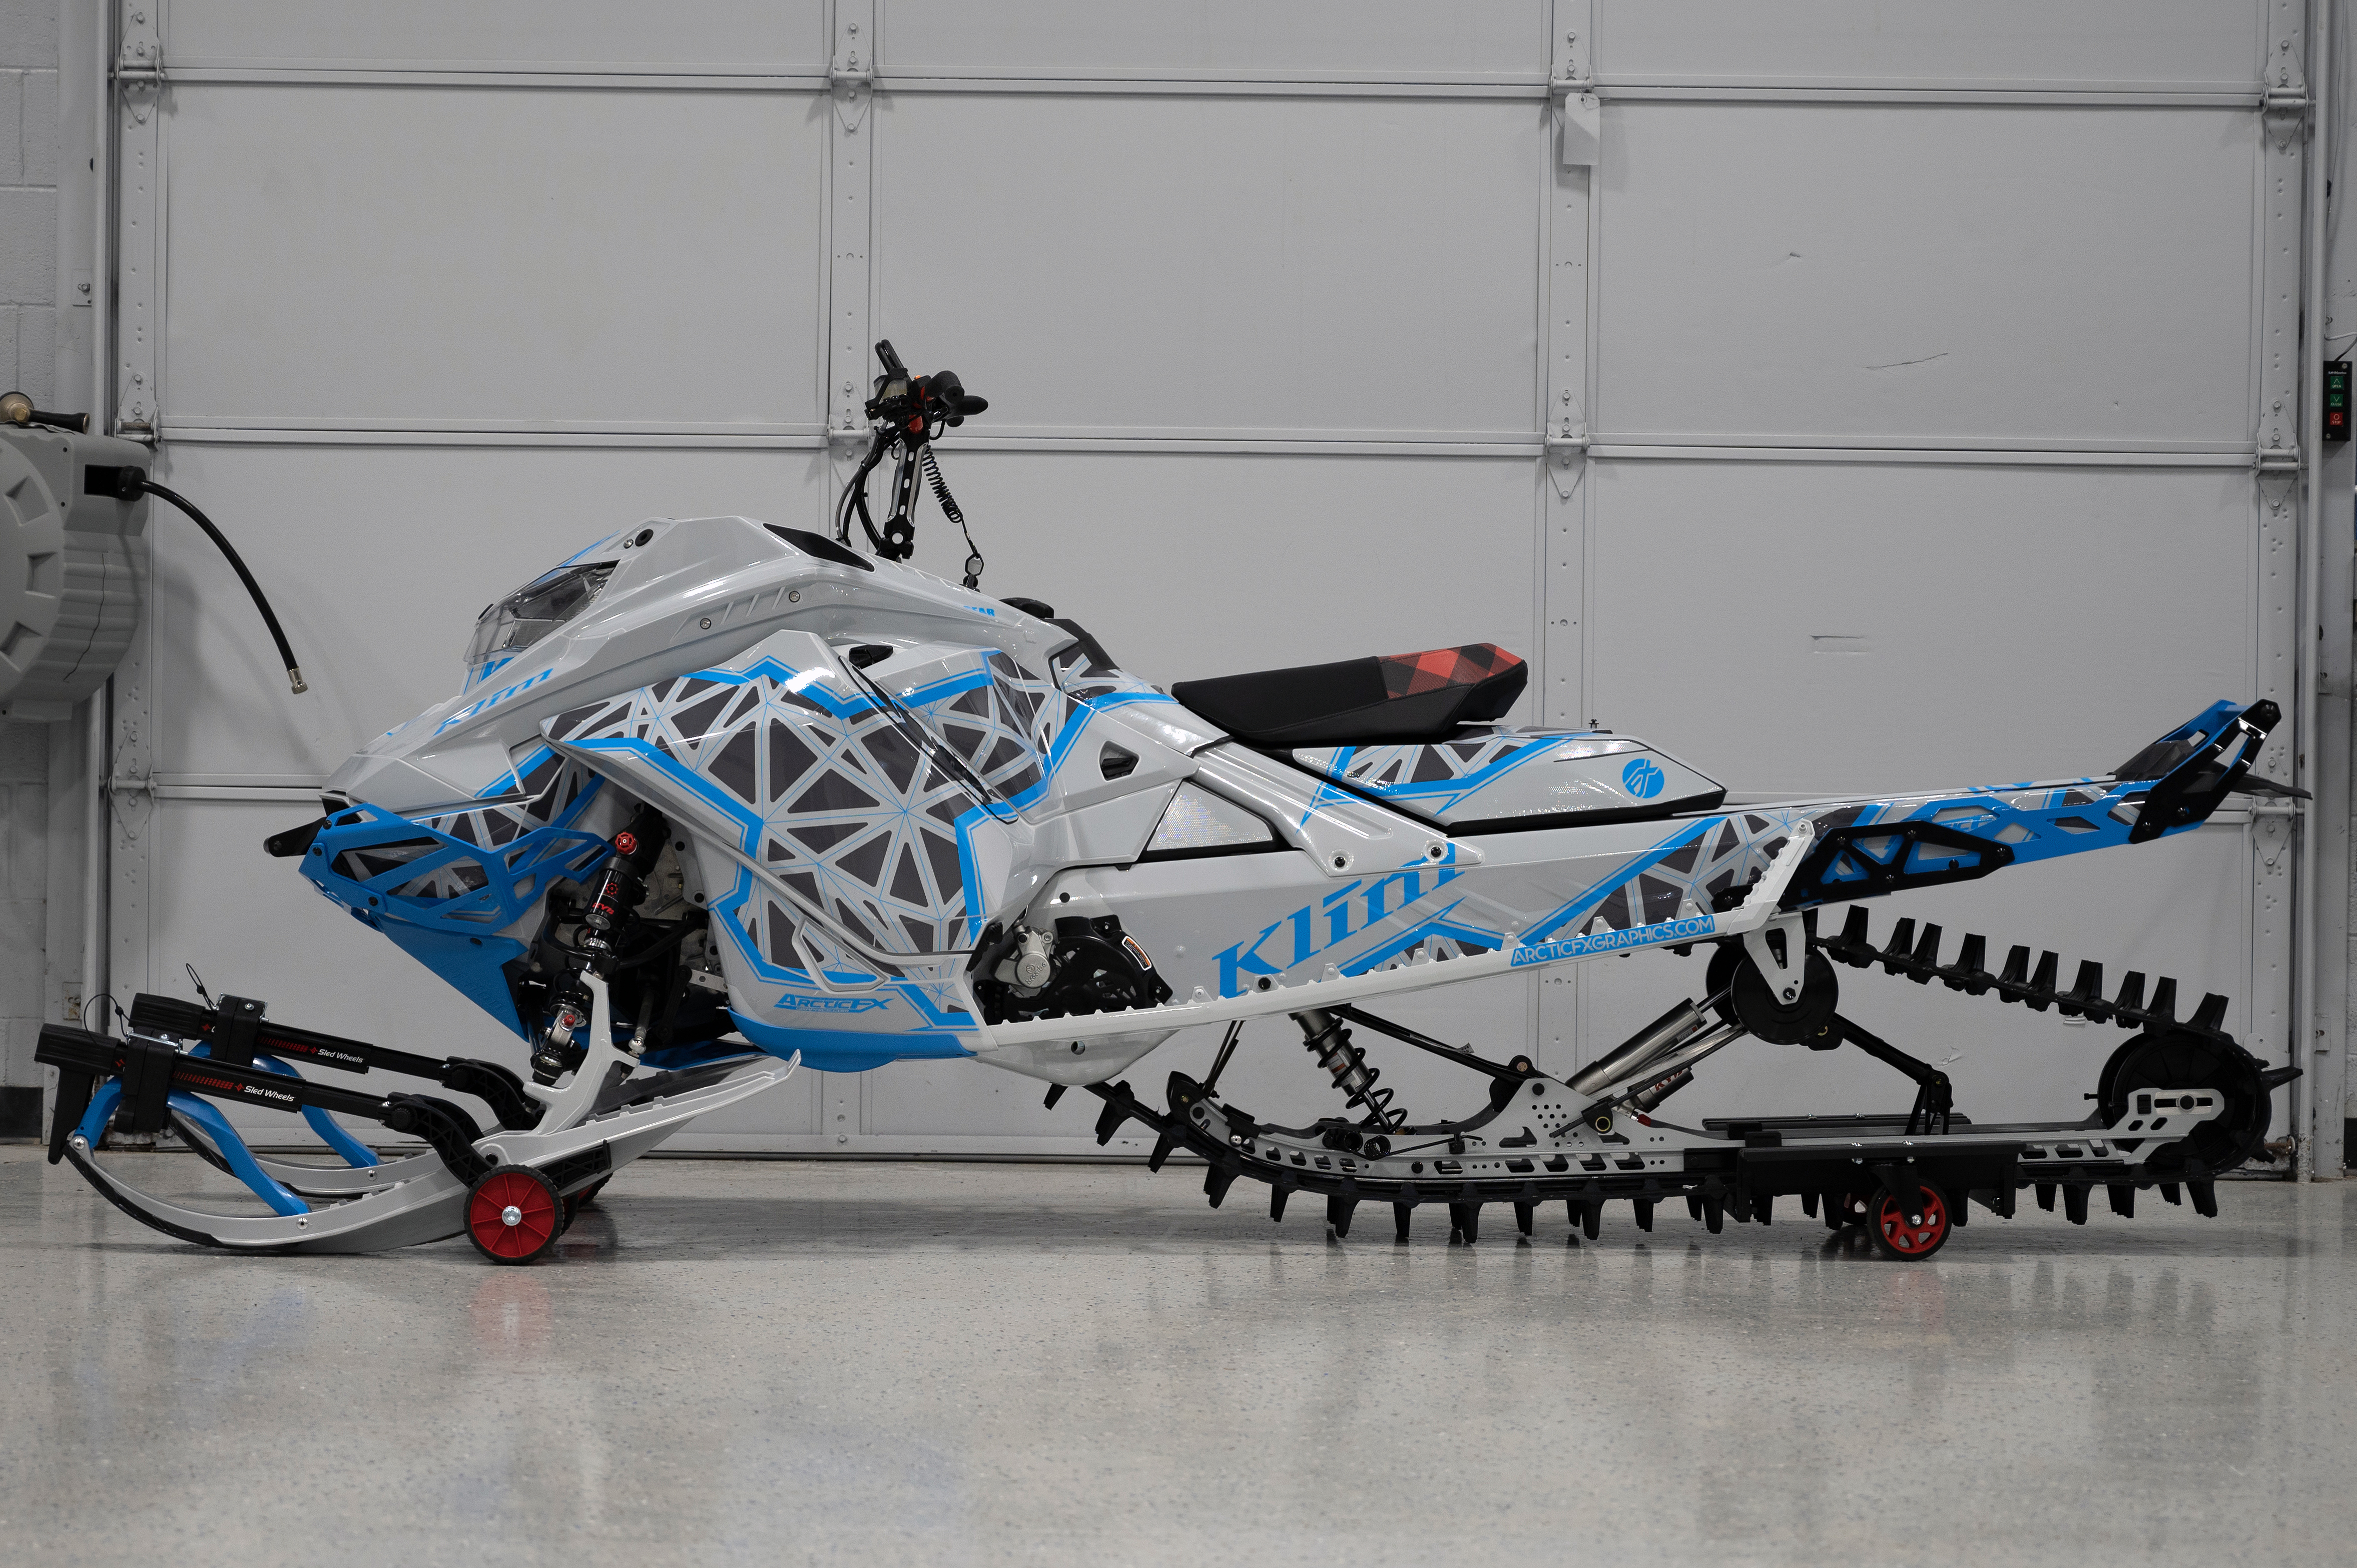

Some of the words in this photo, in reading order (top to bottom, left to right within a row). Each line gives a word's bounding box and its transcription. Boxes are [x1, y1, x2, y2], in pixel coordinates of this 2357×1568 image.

[1512, 918, 1714, 965] ARCTICFXGRAPHICS.COM
[318, 1049, 336, 1057] Sled
[336, 1052, 363, 1063] Wheels
[244, 1085, 264, 1095] Sled
[265, 1089, 294, 1102] Wheels
